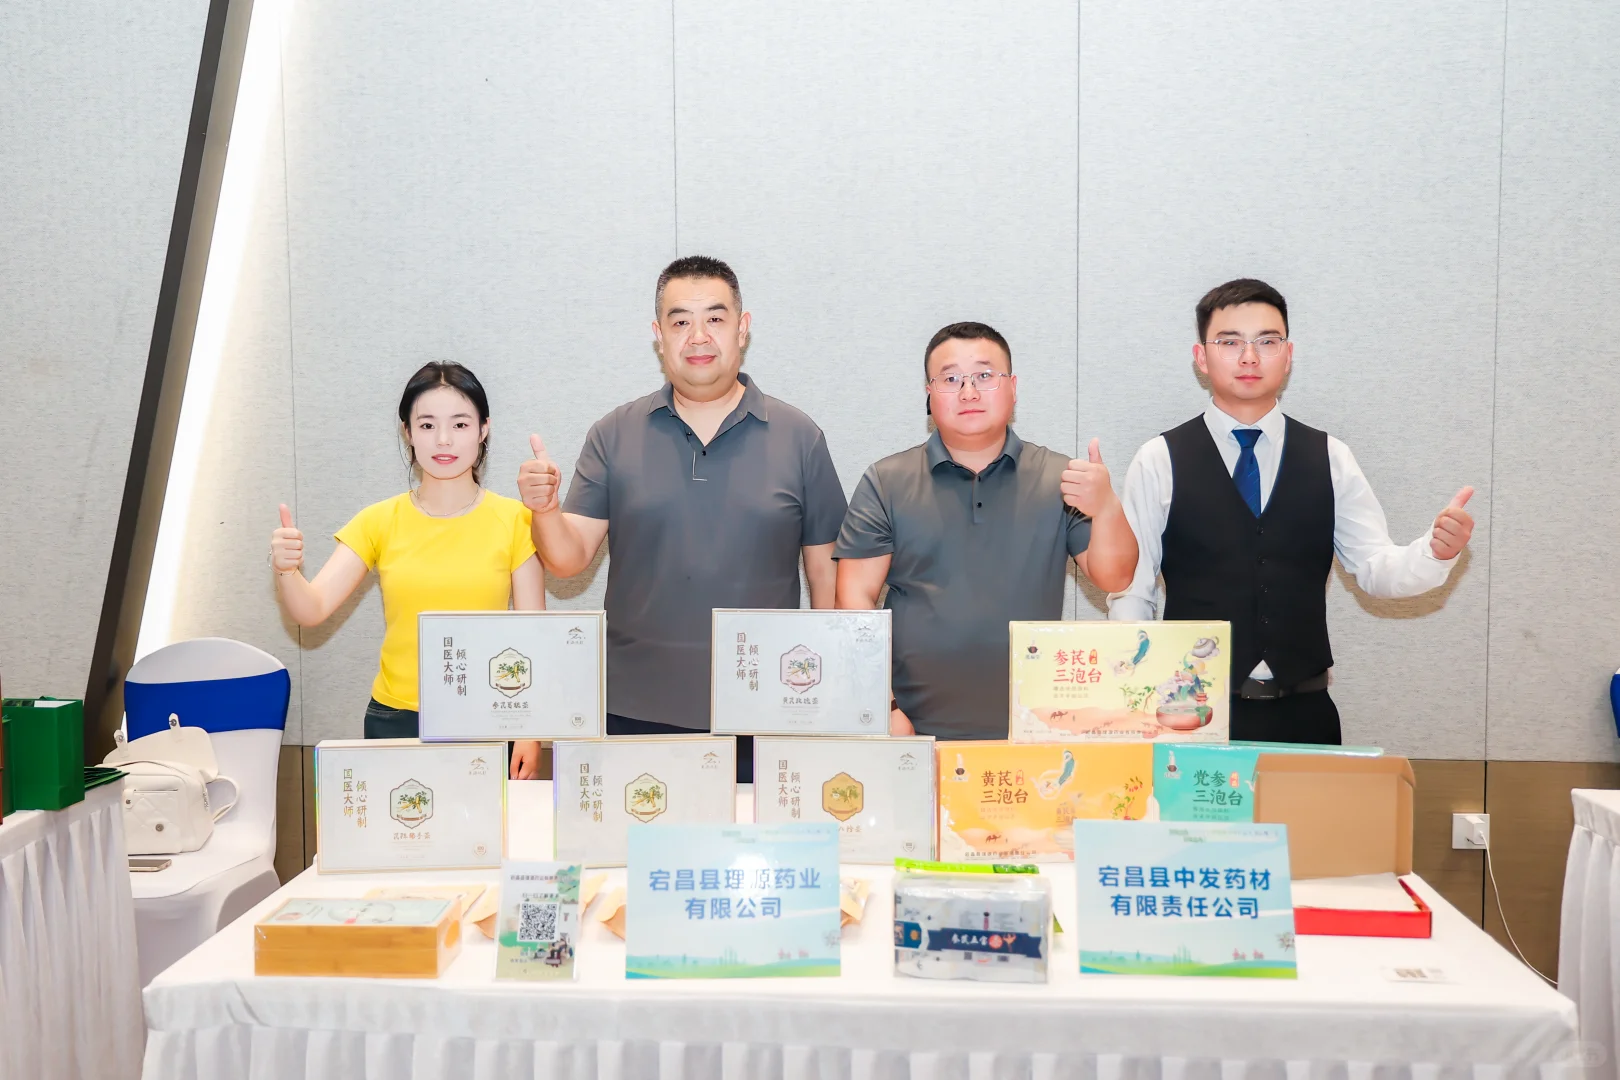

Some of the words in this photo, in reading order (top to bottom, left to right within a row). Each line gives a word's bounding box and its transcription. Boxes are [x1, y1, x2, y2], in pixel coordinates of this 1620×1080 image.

[443, 637, 454, 686] 国医大师
[456, 649, 467, 697] 倾心研制
[736, 632, 747, 680] 国医大师
[748, 644, 759, 691] 倾心研制
[1053, 649, 1086, 666] 参芪
[1053, 668, 1102, 684] 三泡台
[343, 768, 354, 818] 国医大师
[579, 763, 590, 811] 国医大师
[778, 759, 789, 807] 国医大师
[790, 772, 801, 819] 倾心研制
[981, 770, 1013, 787] 黄芪
[981, 788, 1028, 804] 三泡台
[1193, 769, 1227, 787] 党参
[356, 781, 367, 828] 倾心研制
[593, 774, 604, 823] 倾心研制
[1192, 789, 1243, 806] 三泡台
[649, 868, 821, 891] 宕昌县理源药业
[1098, 866, 1271, 891] 宕昌县中发药材
[685, 897, 783, 920] 有限公司
[1110, 894, 1259, 919] 有限责任公司
